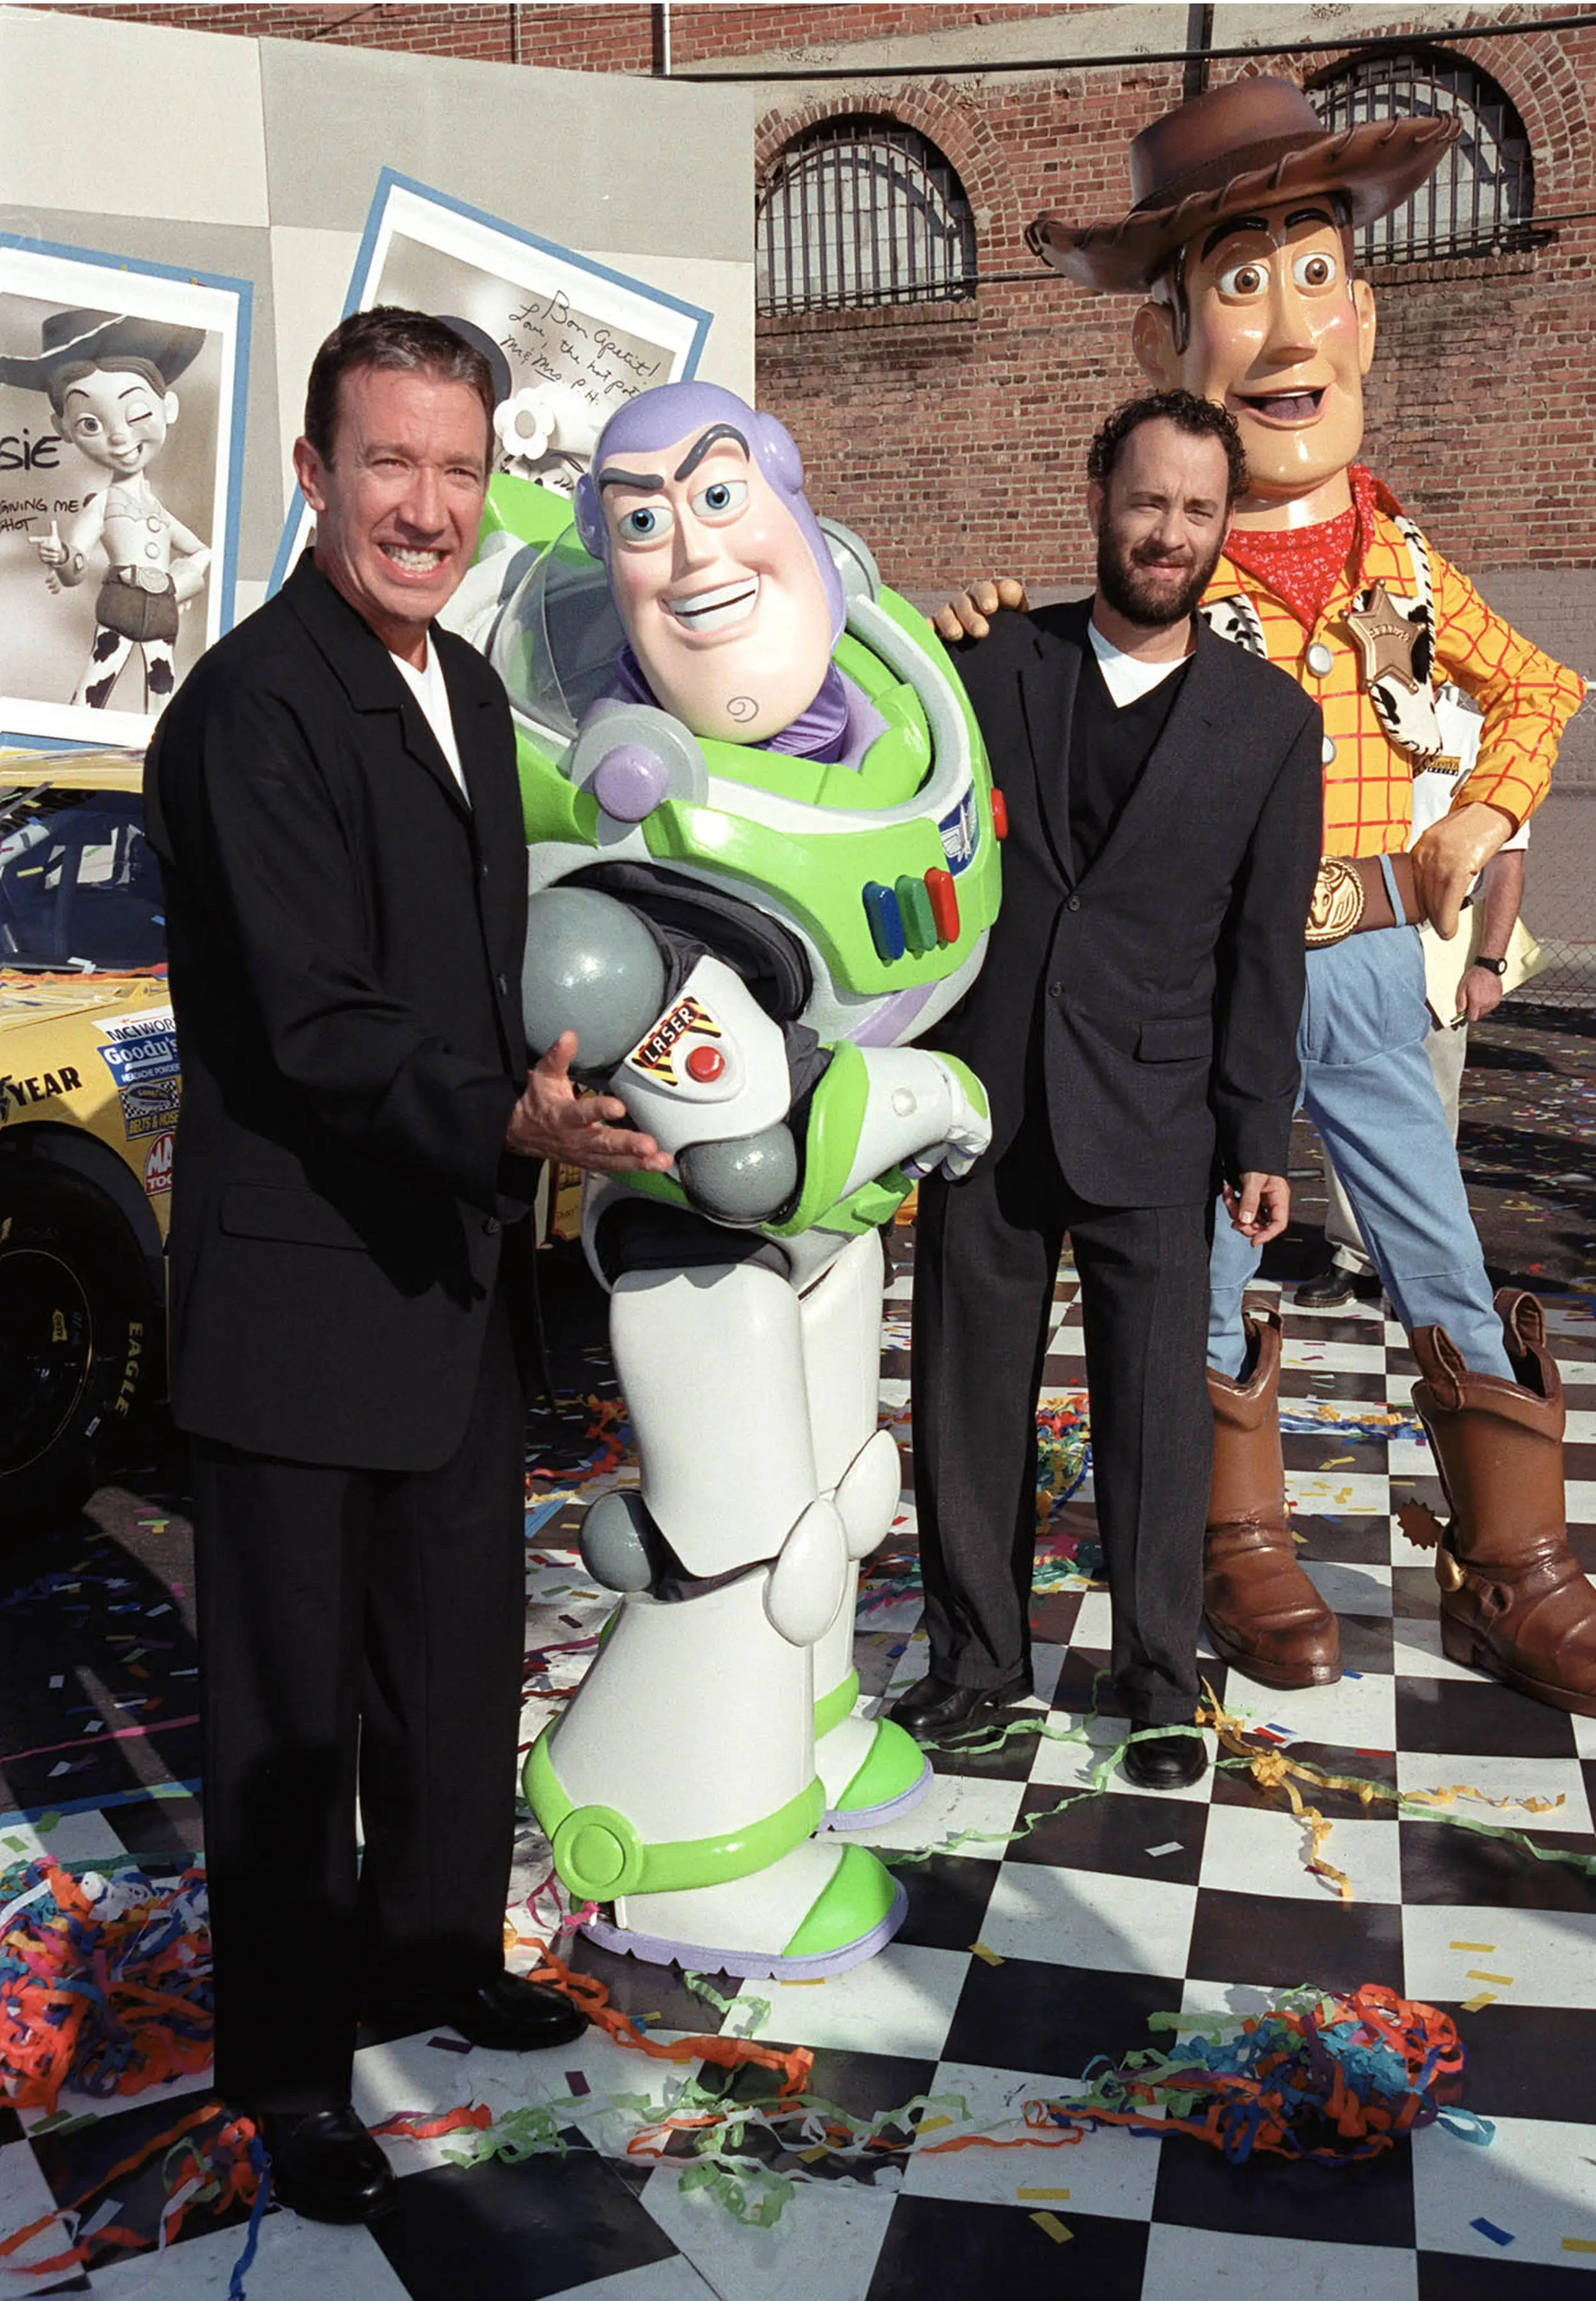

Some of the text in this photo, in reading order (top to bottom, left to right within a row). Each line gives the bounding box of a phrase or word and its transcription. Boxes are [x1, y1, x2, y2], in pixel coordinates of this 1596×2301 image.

[541, 290, 588, 339] Bon
[54, 500, 79, 513] ME
[644, 1007, 694, 1063] LASER
[6, 1066, 83, 1107] YEAR
[114, 1321, 143, 1416] EAGLE
